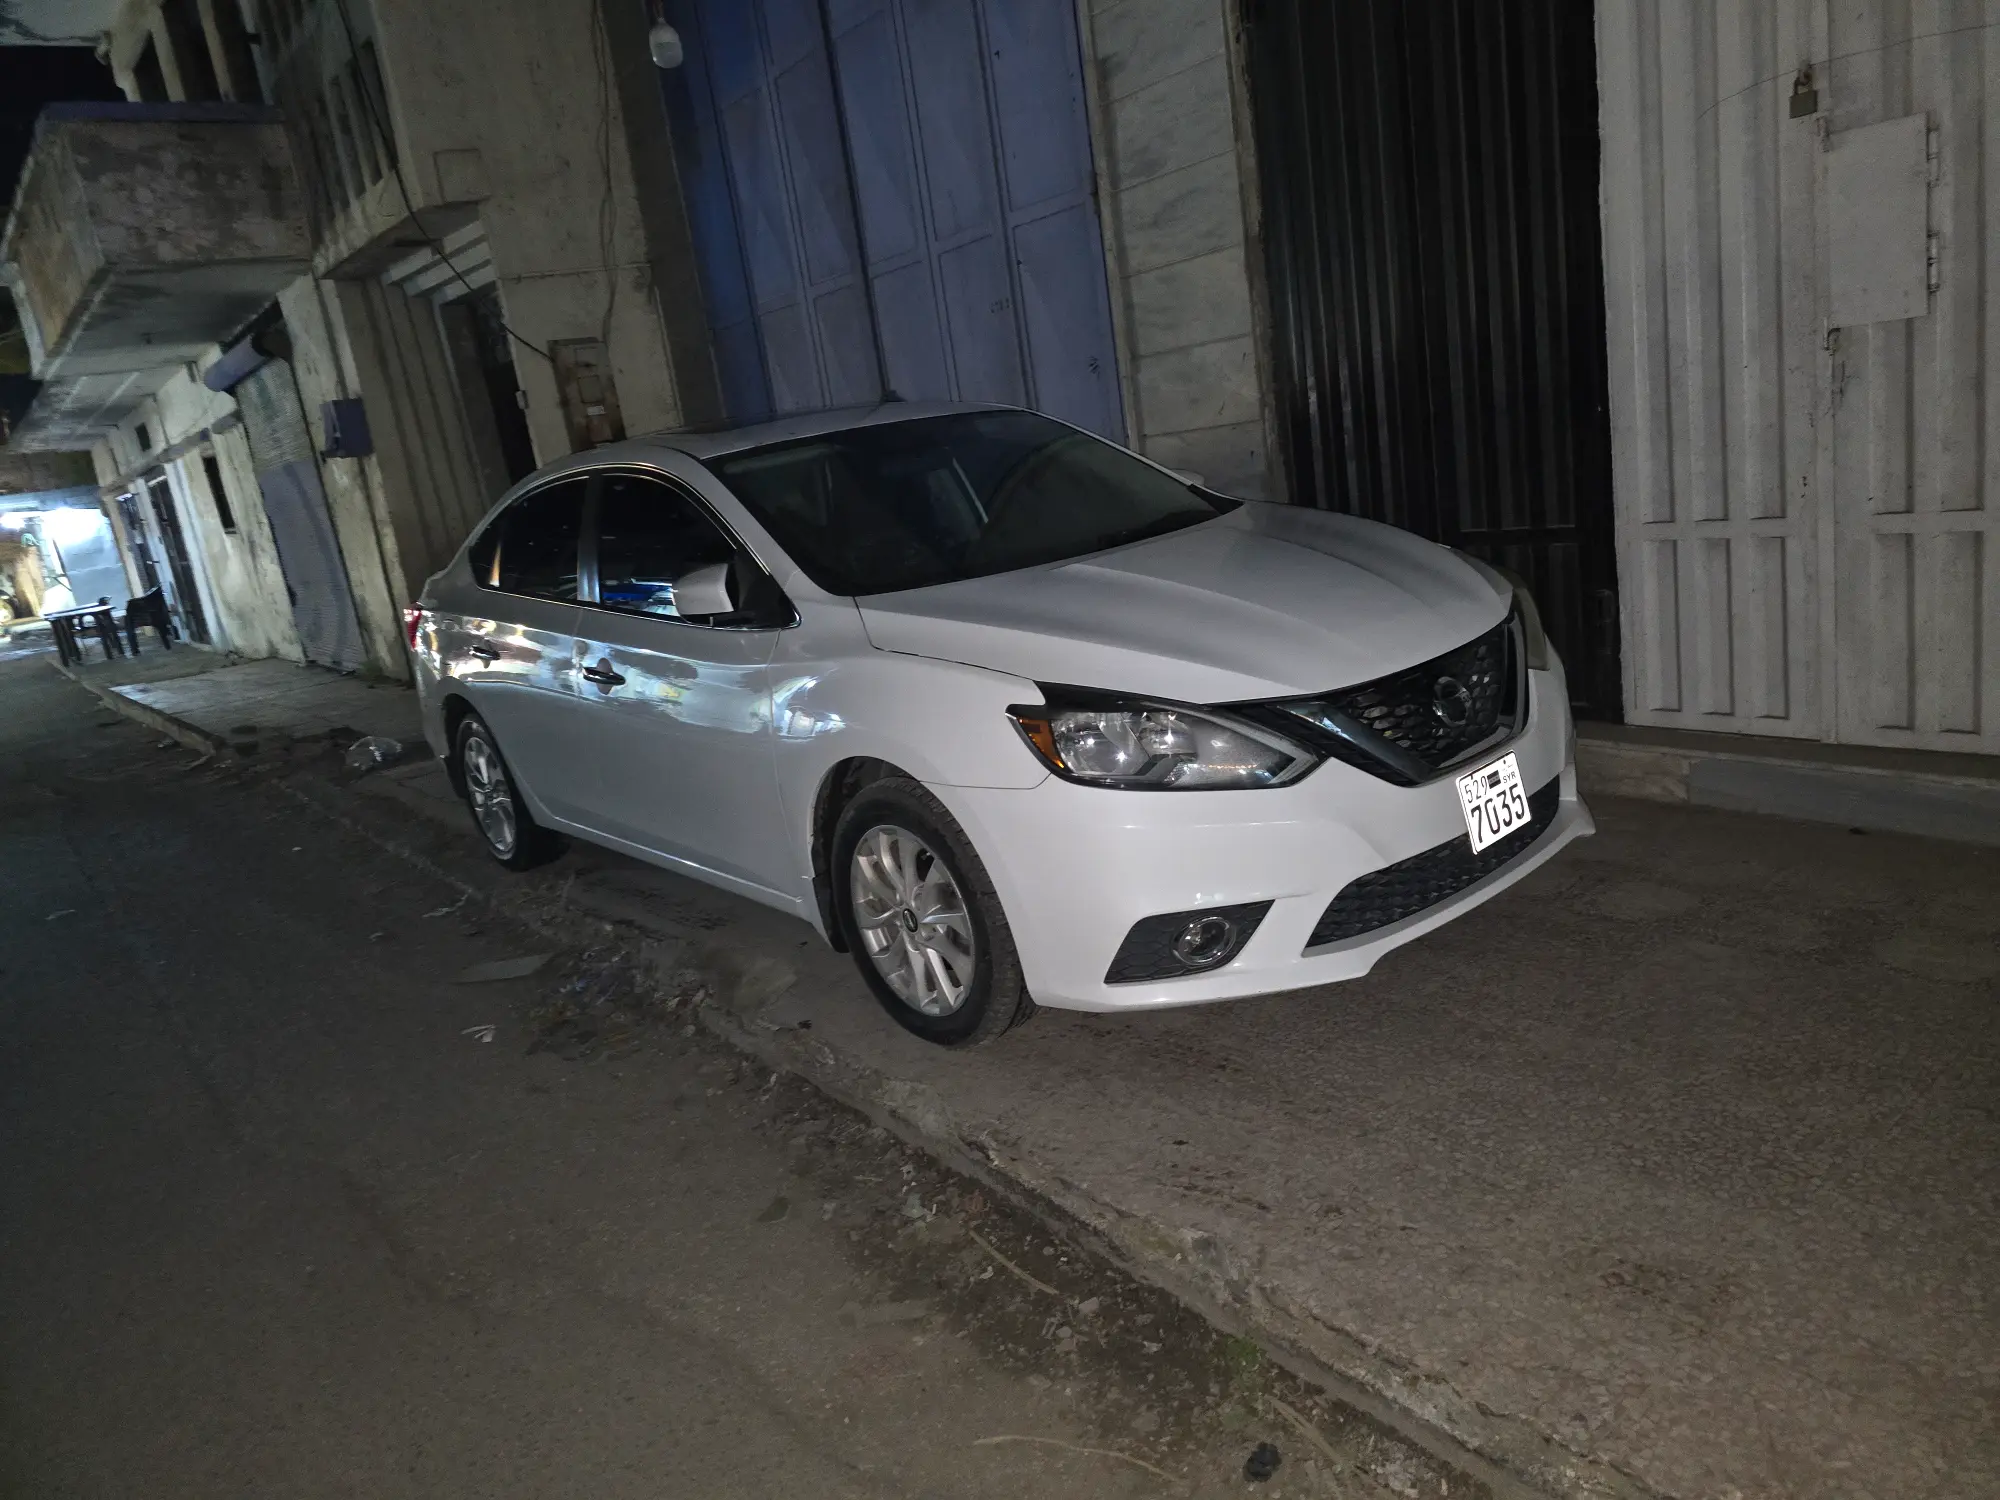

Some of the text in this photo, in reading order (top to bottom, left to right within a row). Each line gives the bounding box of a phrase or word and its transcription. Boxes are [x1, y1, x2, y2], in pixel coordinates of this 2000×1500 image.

[1464, 771, 1516, 803] 529 SYR
[1470, 783, 1525, 843] 7035
